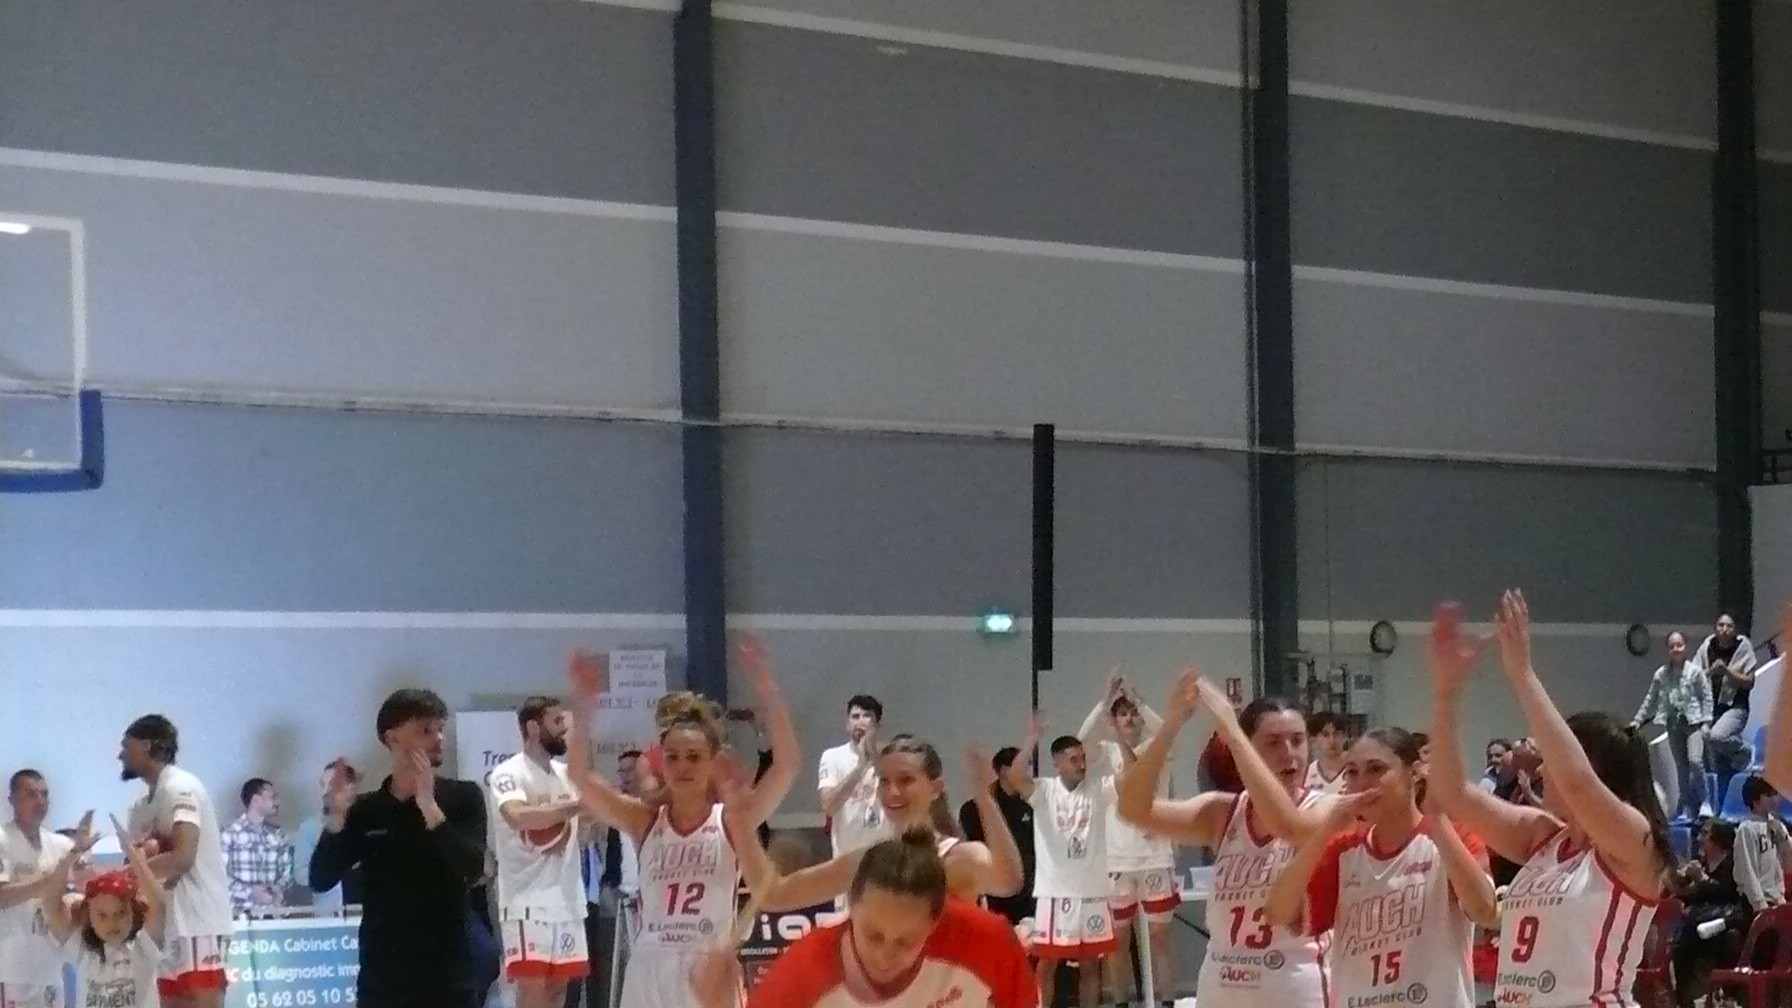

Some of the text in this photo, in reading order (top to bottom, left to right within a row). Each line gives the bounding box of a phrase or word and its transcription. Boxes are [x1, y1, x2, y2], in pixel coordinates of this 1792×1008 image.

[666, 882, 706, 916] 12
[1229, 905, 1274, 950] 13
[1511, 915, 1540, 964] 9
[222, 934, 359, 956] GENDA Cabinet Ca
[241, 965, 261, 982] du
[264, 963, 336, 983] diagnostic
[1370, 950, 1403, 987] 15
[246, 992, 268, 1008] 05
[271, 991, 293, 1007] 62
[296, 989, 317, 1006] 05
[321, 987, 341, 1004] 10
